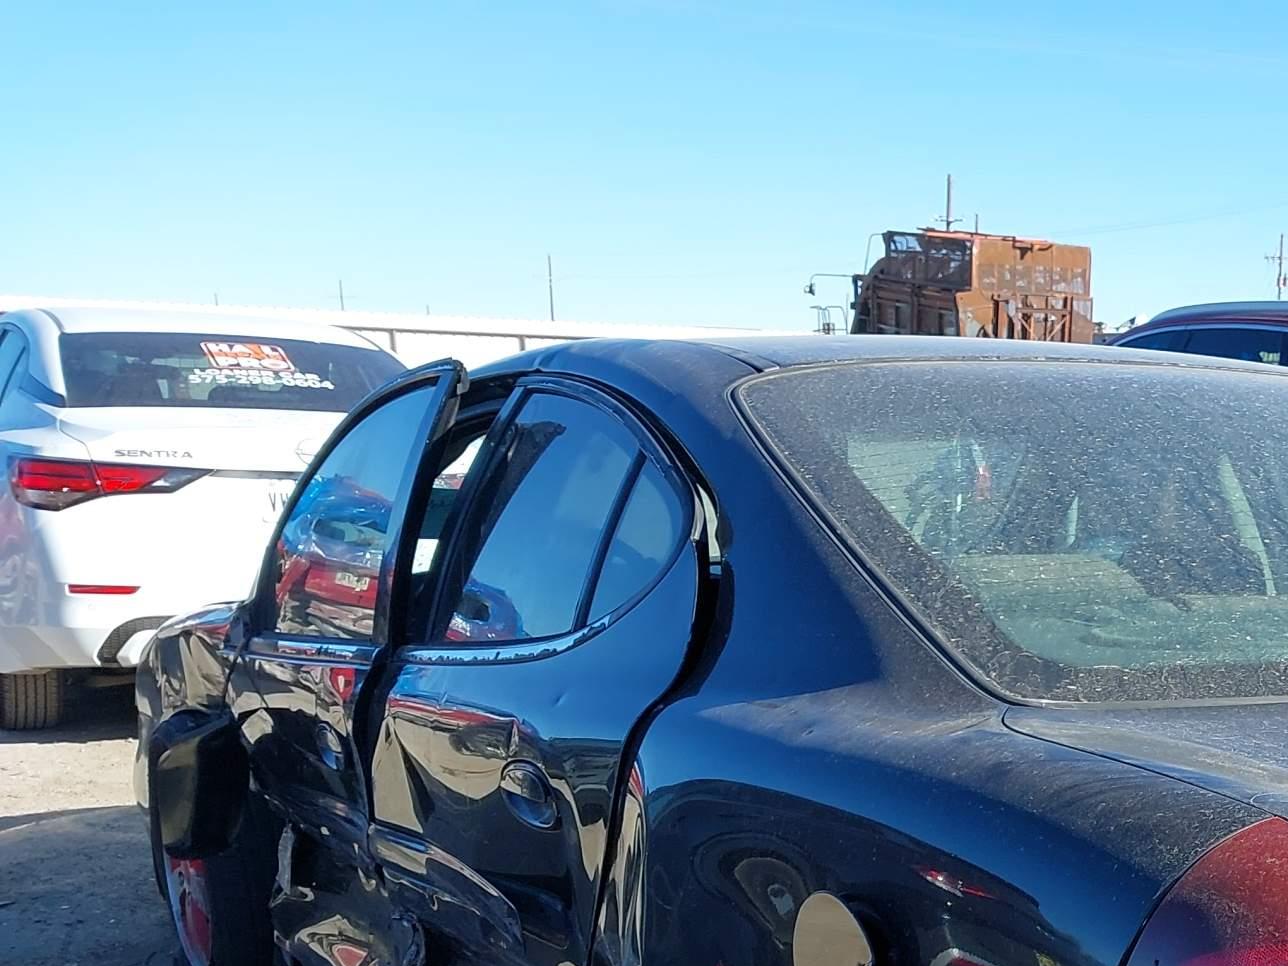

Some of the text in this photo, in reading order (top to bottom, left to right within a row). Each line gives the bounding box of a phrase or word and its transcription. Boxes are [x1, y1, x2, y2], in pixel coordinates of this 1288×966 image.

[214, 357, 290, 368] PRO
[278, 371, 321, 380] CAR
[114, 449, 193, 459] SENTRA
